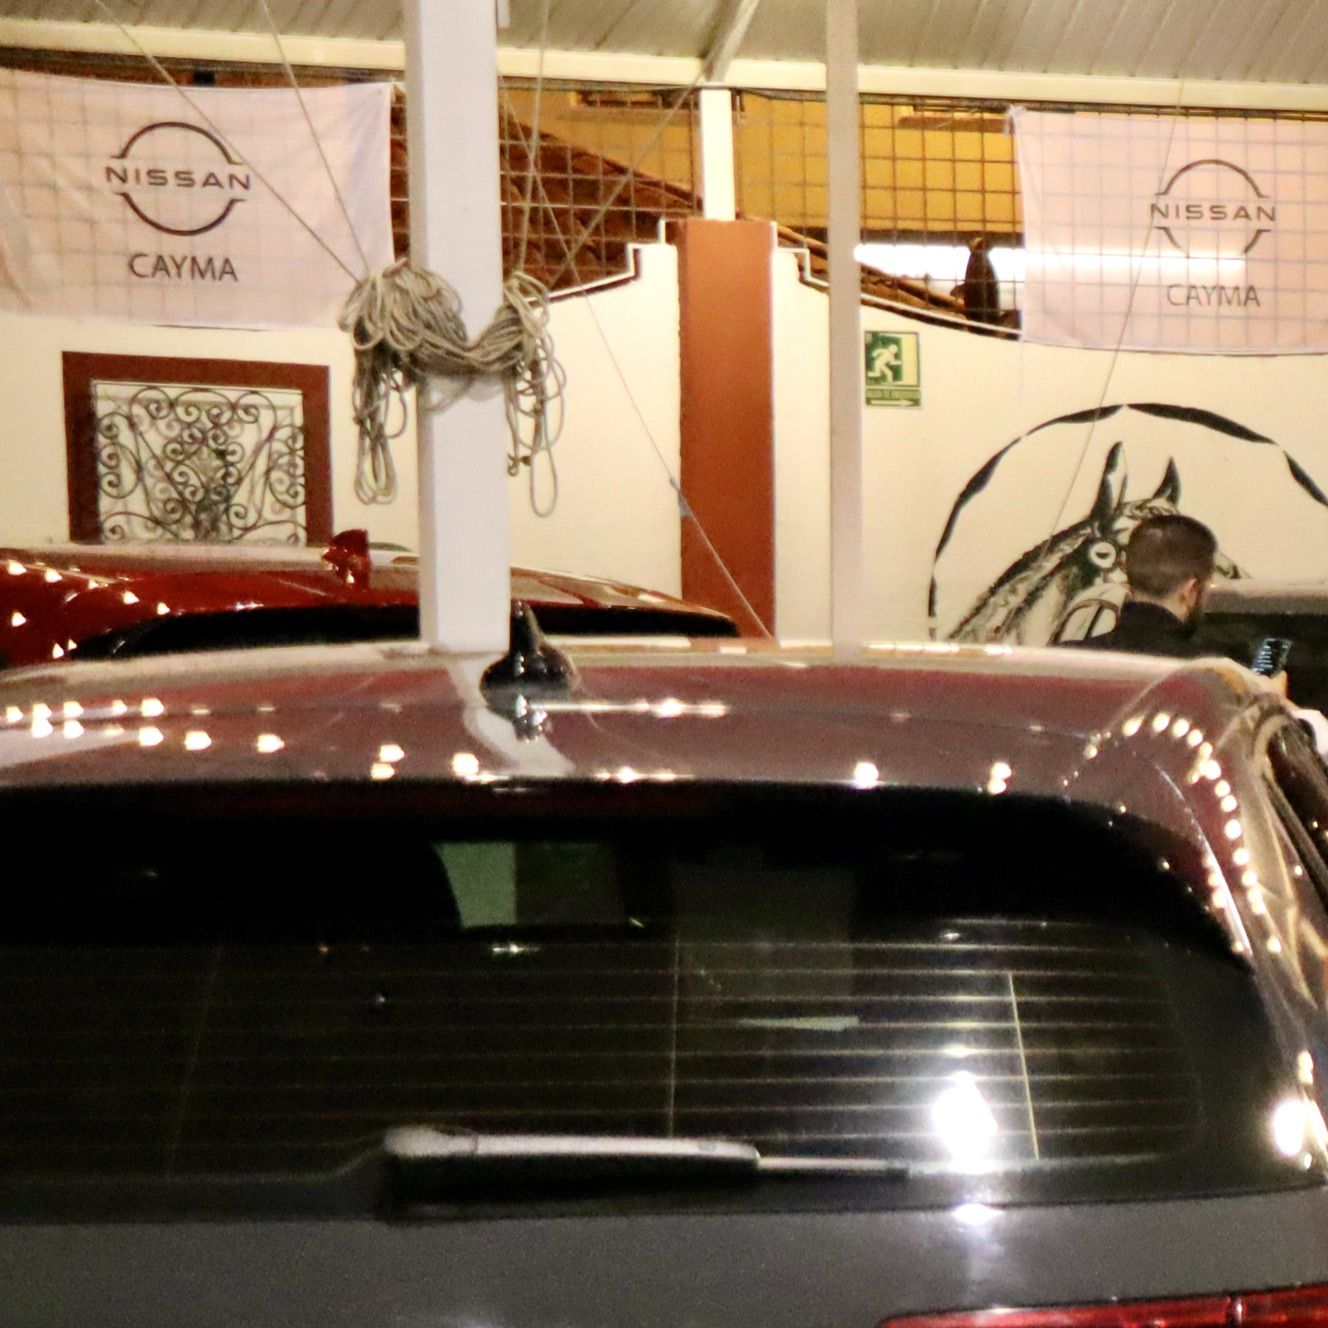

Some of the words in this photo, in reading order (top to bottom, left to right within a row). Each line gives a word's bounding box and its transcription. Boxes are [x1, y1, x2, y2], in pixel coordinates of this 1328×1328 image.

[104, 165, 252, 191] NISSAN
[1149, 202, 1276, 222] NISSAN
[128, 253, 238, 282] CAYMA
[1167, 284, 1261, 307] CAYMA
